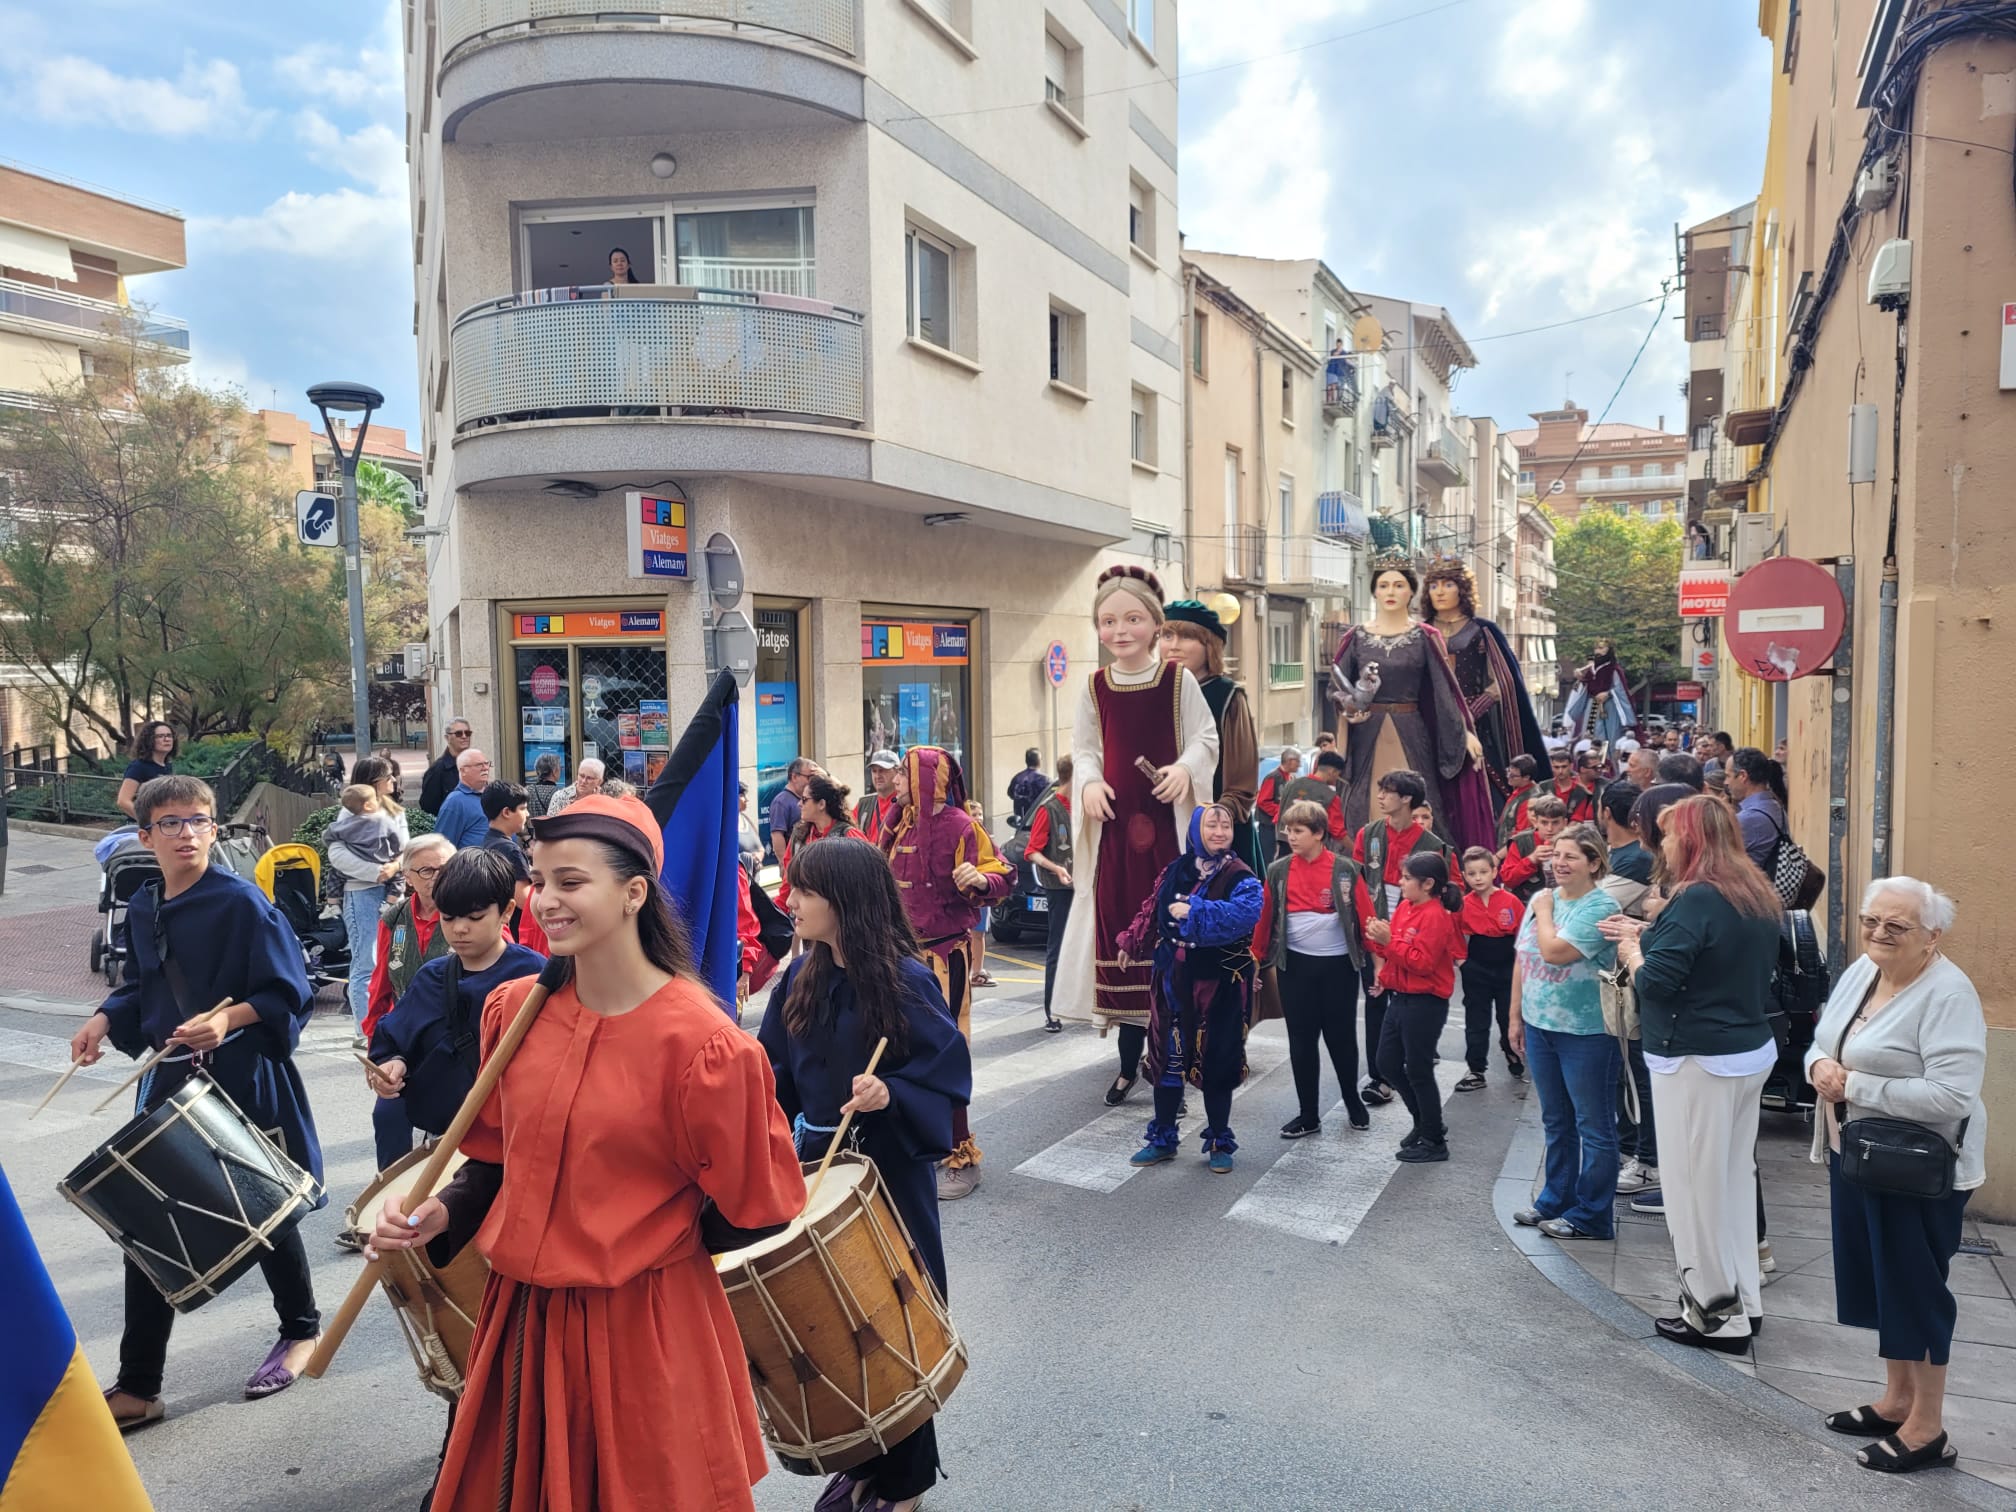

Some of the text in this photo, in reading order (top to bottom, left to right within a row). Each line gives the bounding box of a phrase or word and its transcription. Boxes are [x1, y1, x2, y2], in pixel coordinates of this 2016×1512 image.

[650, 528, 679, 549] Viatges
[1682, 598, 1727, 608] MOTUL
[588, 617, 616, 628] Viatges
[755, 627, 790, 653] Viatges
[905, 630, 932, 651] Viatges
[396, 661, 404, 674] tr
[1035, 899, 1048, 910] 76
